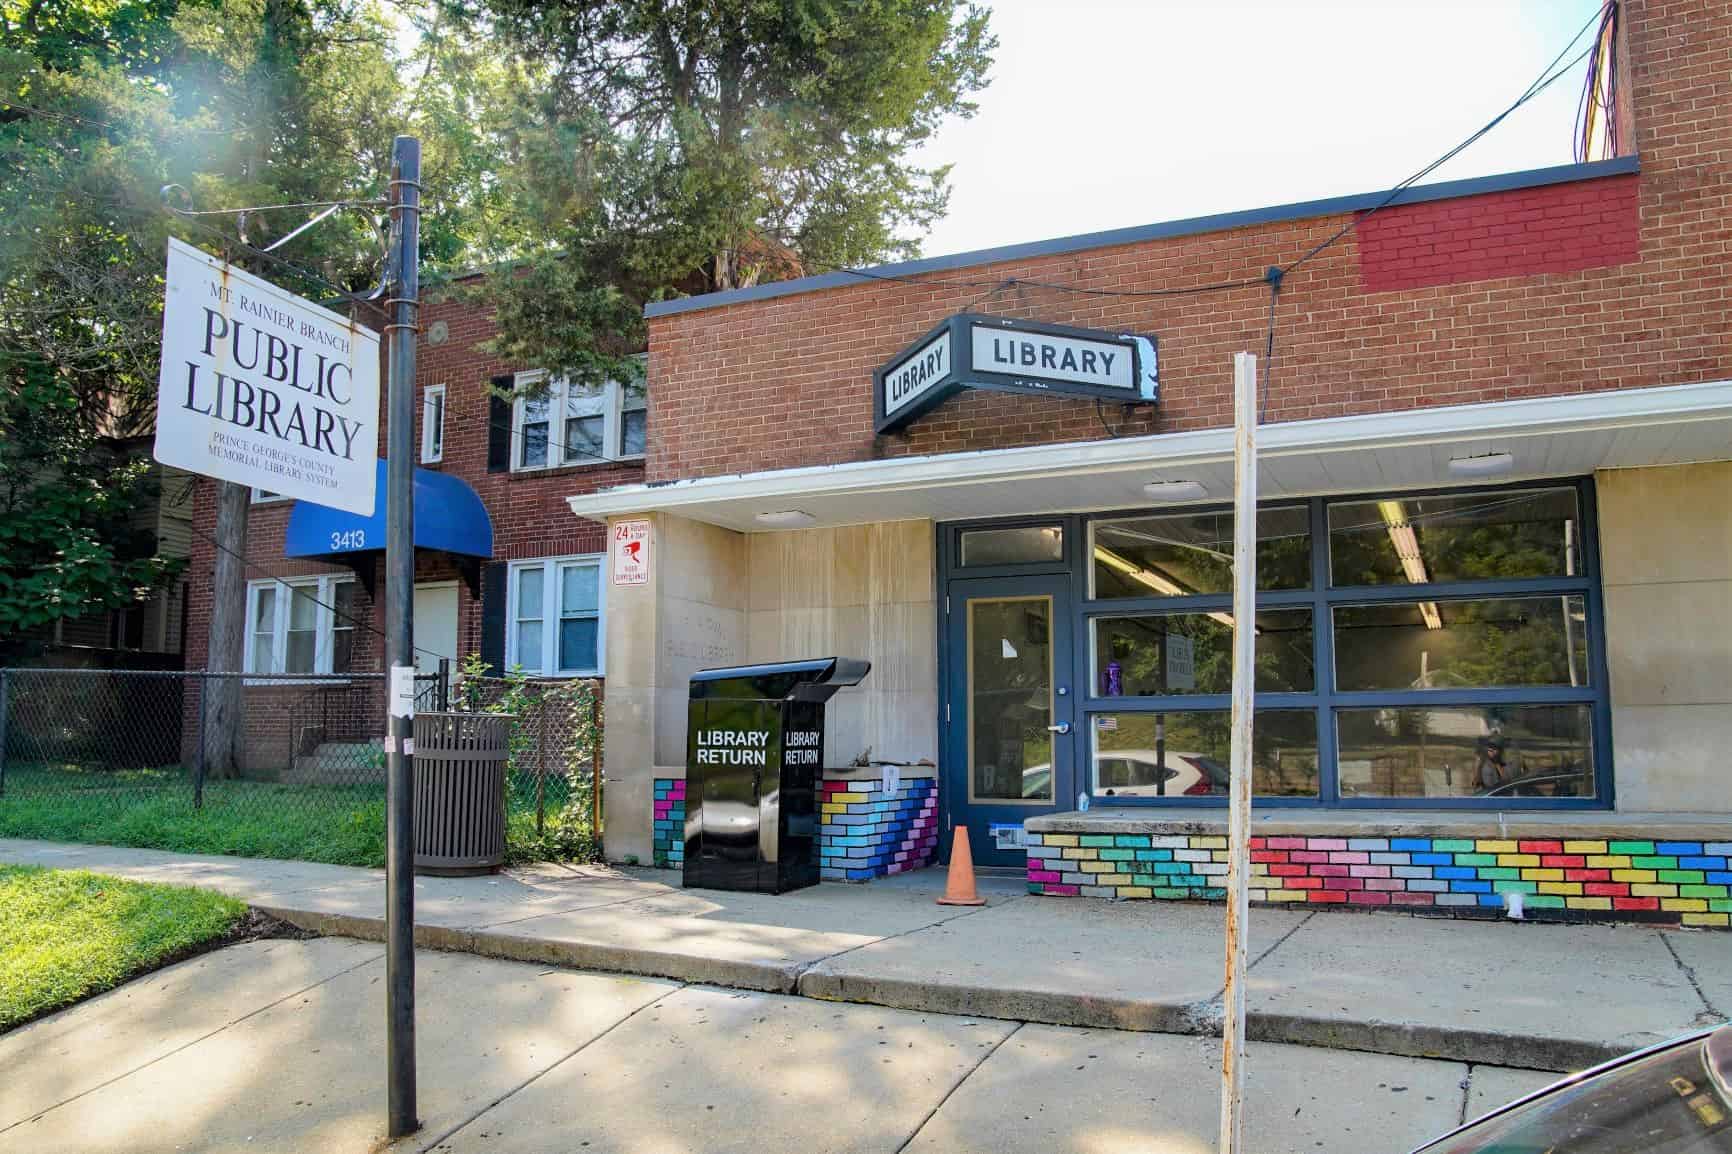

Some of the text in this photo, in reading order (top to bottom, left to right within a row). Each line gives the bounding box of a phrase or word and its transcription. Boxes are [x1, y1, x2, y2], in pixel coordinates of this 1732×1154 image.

[240, 295, 294, 329] RAINIER
[300, 321, 350, 353] BRANCH
[200, 306, 353, 405] PUBLIC
[892, 346, 943, 401] LIBRARY
[993, 338, 1115, 376] LIBRARY
[181, 360, 364, 462] LIBRARY
[208, 444, 340, 489] MEMORIAL LIBRARY SYSTEM
[213, 431, 250, 452] PRINCE
[298, 457, 335, 475] COUNTY
[331, 530, 365, 550] 3413
[616, 526, 629, 541] 24
[697, 730, 769, 746] LIBRARY
[697, 749, 766, 765] RETURN
[786, 731, 820, 746] LIBRARY
[785, 750, 819, 765] RETURN
